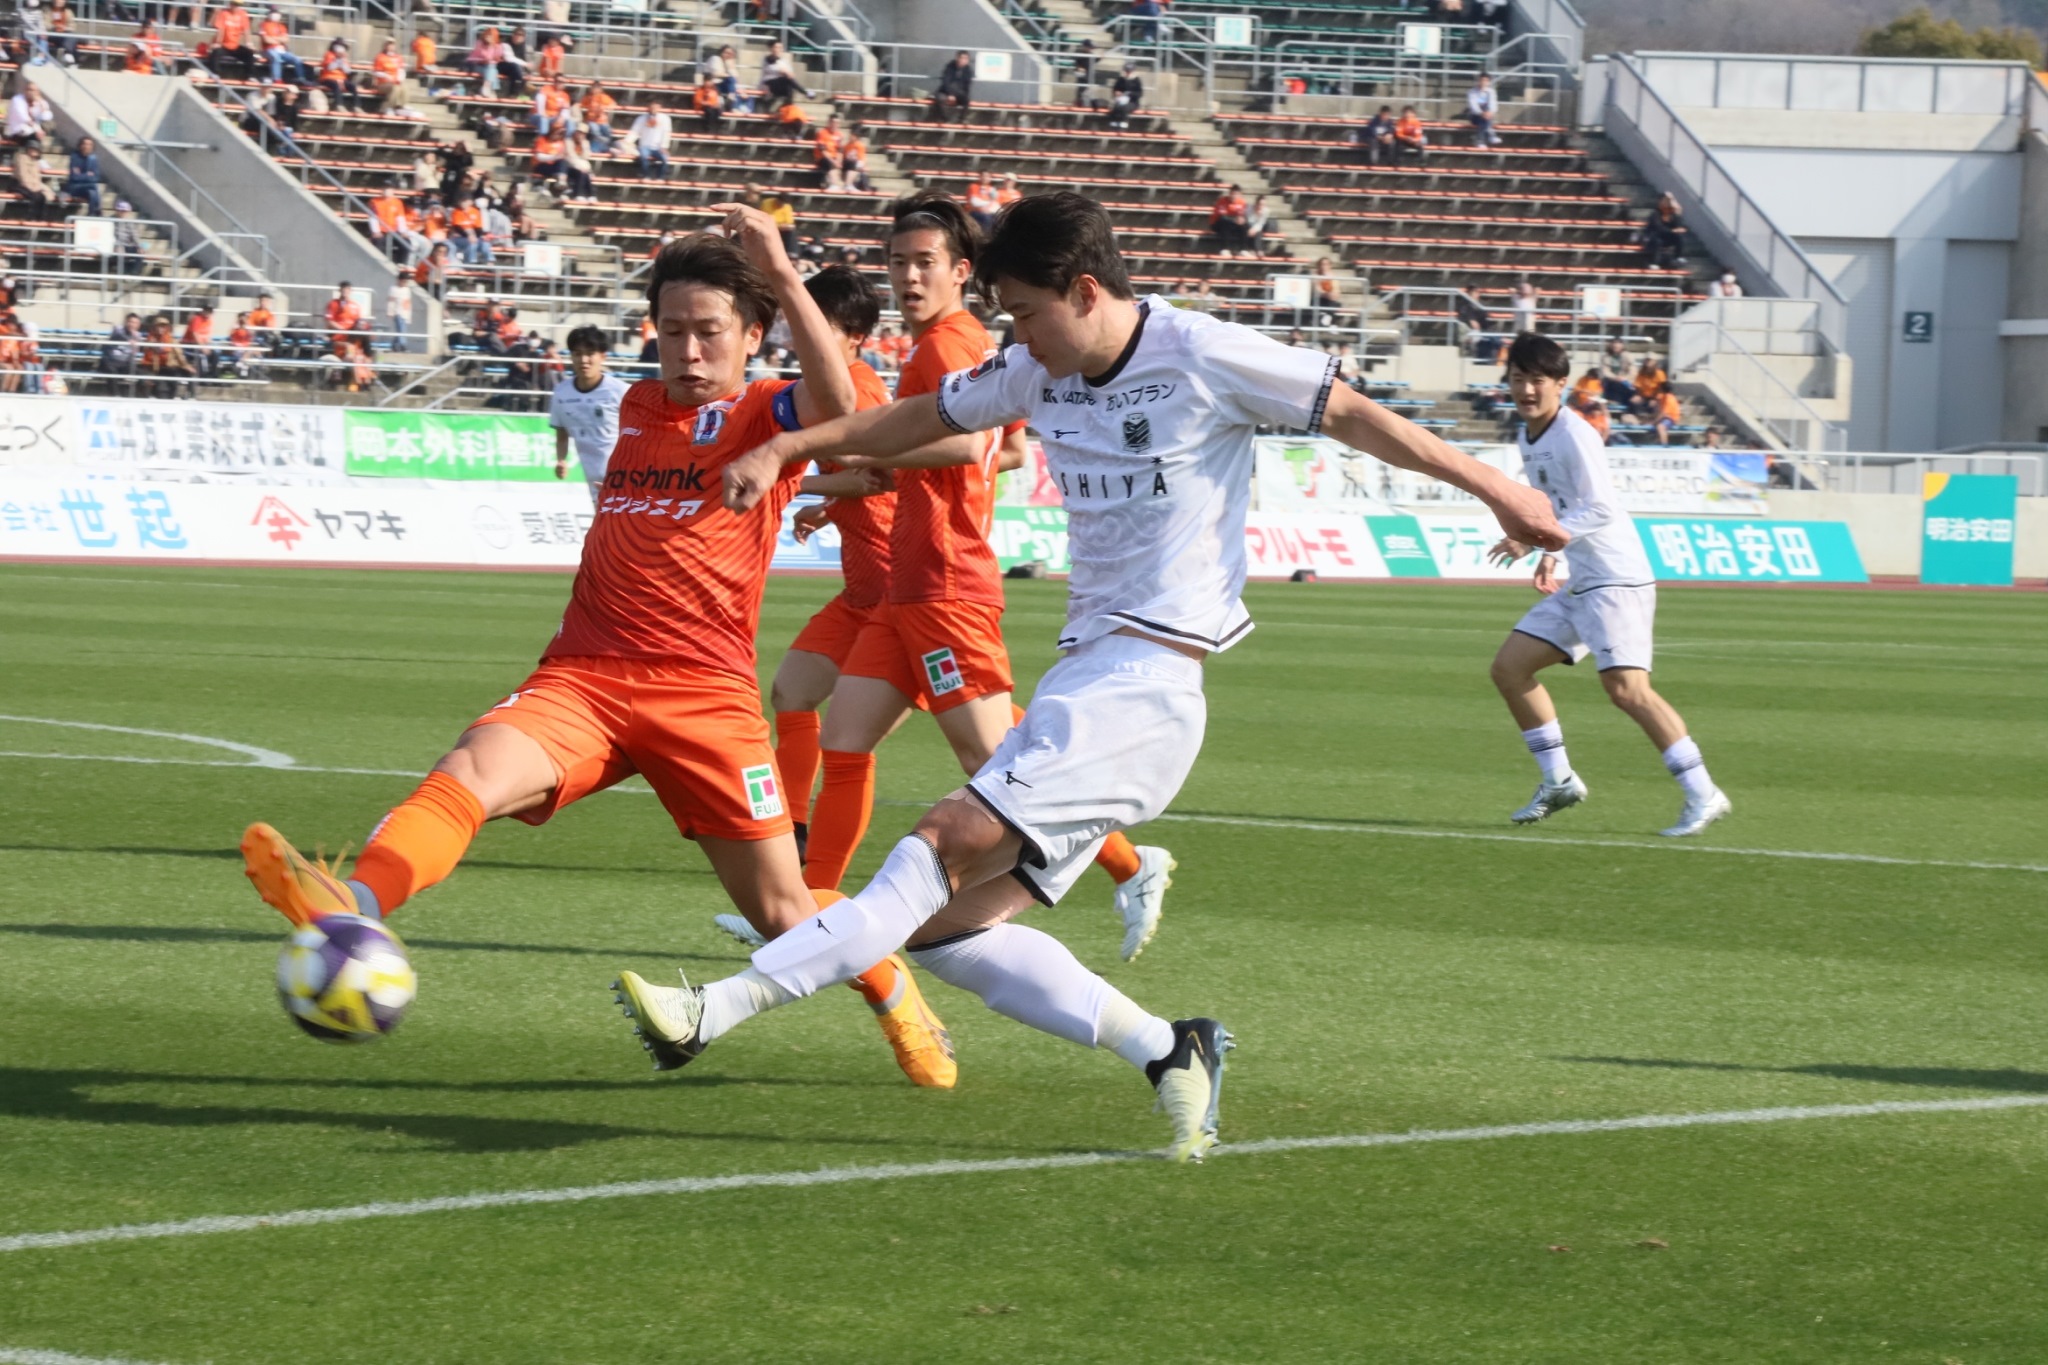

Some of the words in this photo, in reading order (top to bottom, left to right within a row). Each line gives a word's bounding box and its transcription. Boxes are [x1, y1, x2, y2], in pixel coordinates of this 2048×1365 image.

[1910, 314, 1927, 334] 2
[59, 487, 189, 549] 世起
[313, 508, 407, 541] ヤマキ
[1925, 516, 2014, 543] 明治安田
[1244, 526, 1355, 566] マルトモ
[1649, 523, 1822, 577] 明治安田
[933, 677, 962, 694] FUJI
[754, 803, 782, 817] FUJI
